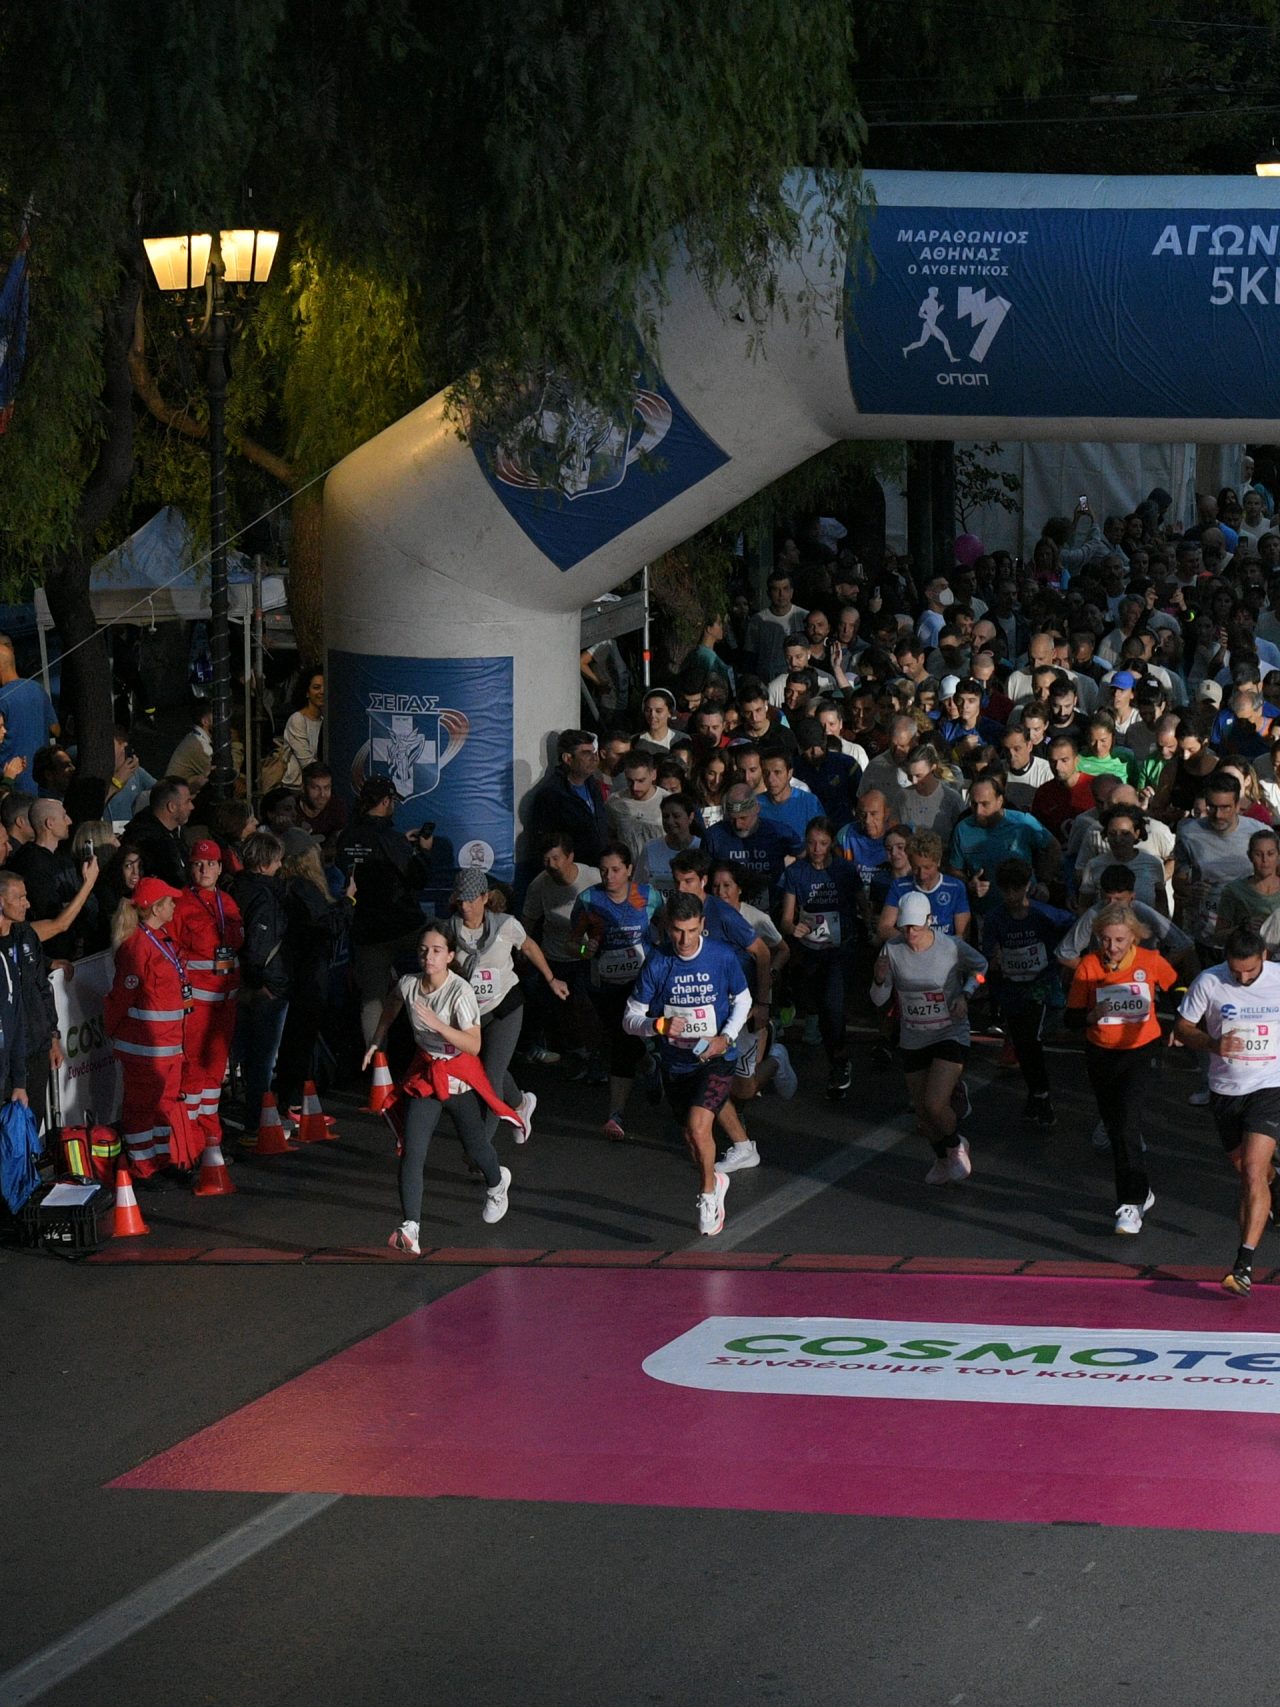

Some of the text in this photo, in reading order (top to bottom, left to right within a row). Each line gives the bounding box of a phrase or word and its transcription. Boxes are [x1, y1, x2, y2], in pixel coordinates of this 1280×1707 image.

[897, 229, 1029, 245] ΜΑΡΑΘΩΝΙΟΣ
[920, 247, 1001, 262] ΑΘΗΝΑΣ
[907, 264, 1009, 276] Ο ΑΥΘΕΝΤΙΚΟΣ
[368, 693, 440, 713] ΣΕΓΑΣ
[729, 848, 767, 860] run to
[606, 961, 640, 973] 57492
[674, 972, 710, 983] run to
[474, 983, 494, 995] 282
[672, 984, 714, 996] change
[670, 993, 717, 1005] diabetes
[907, 1004, 941, 1016] 64275
[1245, 1039, 1269, 1051] 037
[706, 1356, 945, 1375] Συνδέουμε
[954, 1366, 1028, 1377] τον
[1035, 1369, 1173, 1383] κόσμο
